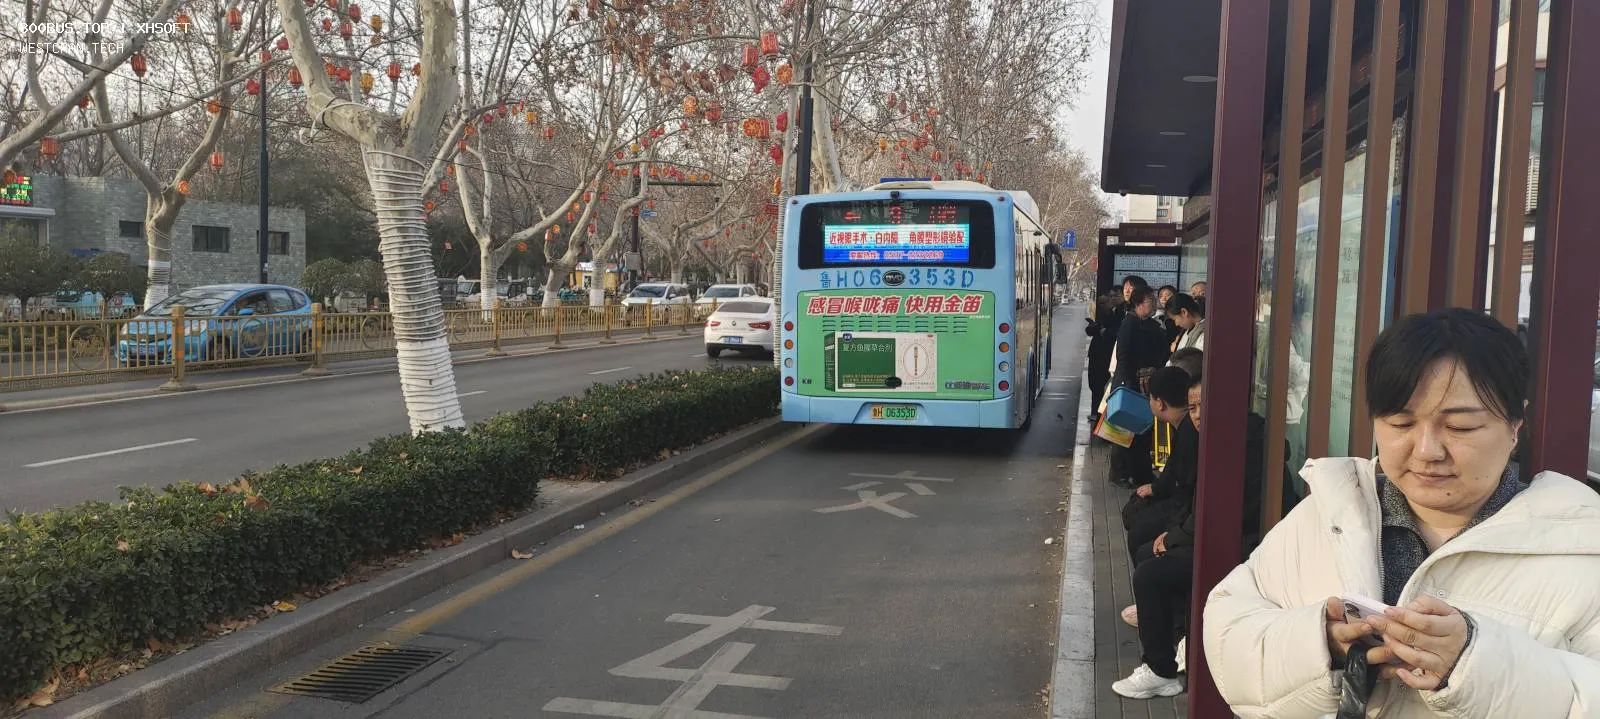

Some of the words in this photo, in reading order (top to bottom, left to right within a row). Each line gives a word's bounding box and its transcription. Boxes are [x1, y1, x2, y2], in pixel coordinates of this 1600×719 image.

[885, 274, 903, 282] BYD
[807, 295, 900, 315] 感冒喉咙痛
[905, 294, 983, 314] 快用金笛
[813, 470, 955, 519] 交
[542, 604, 844, 719] 车
